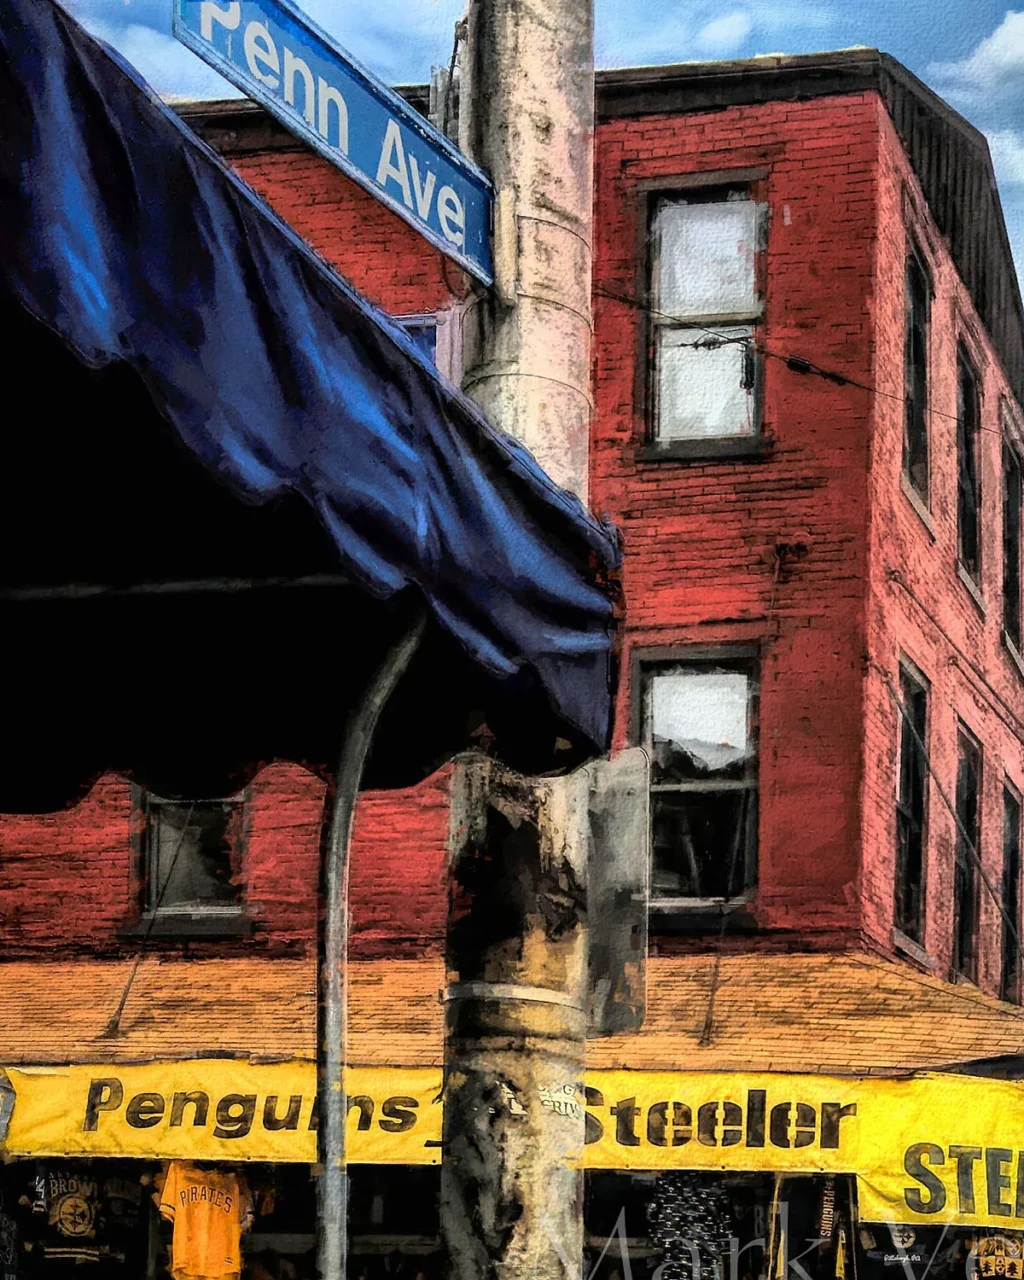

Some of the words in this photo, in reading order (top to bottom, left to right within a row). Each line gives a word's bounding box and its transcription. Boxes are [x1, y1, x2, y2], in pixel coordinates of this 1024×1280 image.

[201, 0, 349, 156] Penn
[375, 118, 466, 247] Ave
[180, 1186, 233, 1214] PIRATES
[820, 1190, 835, 1237] PENGUINS
